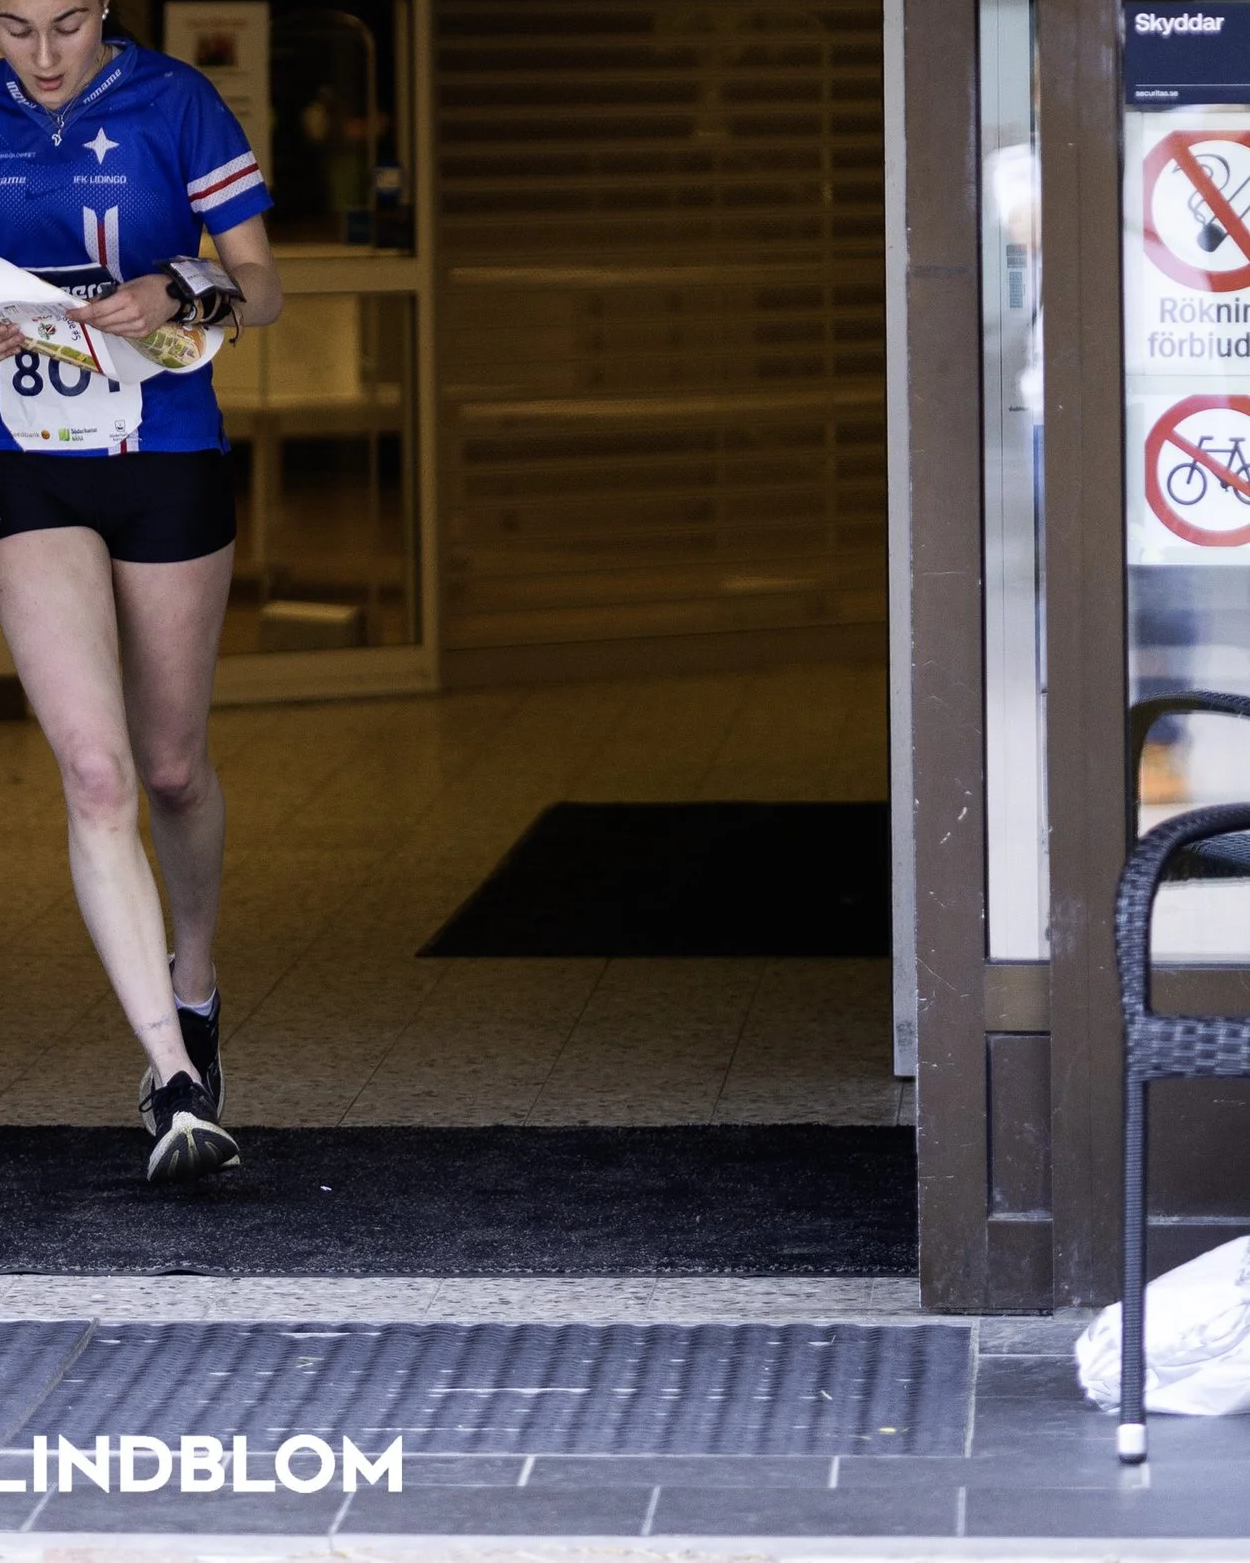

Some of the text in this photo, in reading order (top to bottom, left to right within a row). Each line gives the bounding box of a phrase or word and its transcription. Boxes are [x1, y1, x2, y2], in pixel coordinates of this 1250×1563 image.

[1134, 12, 1225, 38] Skyddar
[82, 67, 122, 106] noname
[73, 175, 88, 184] IFK
[1148, 331, 1250, 360] förbjud
